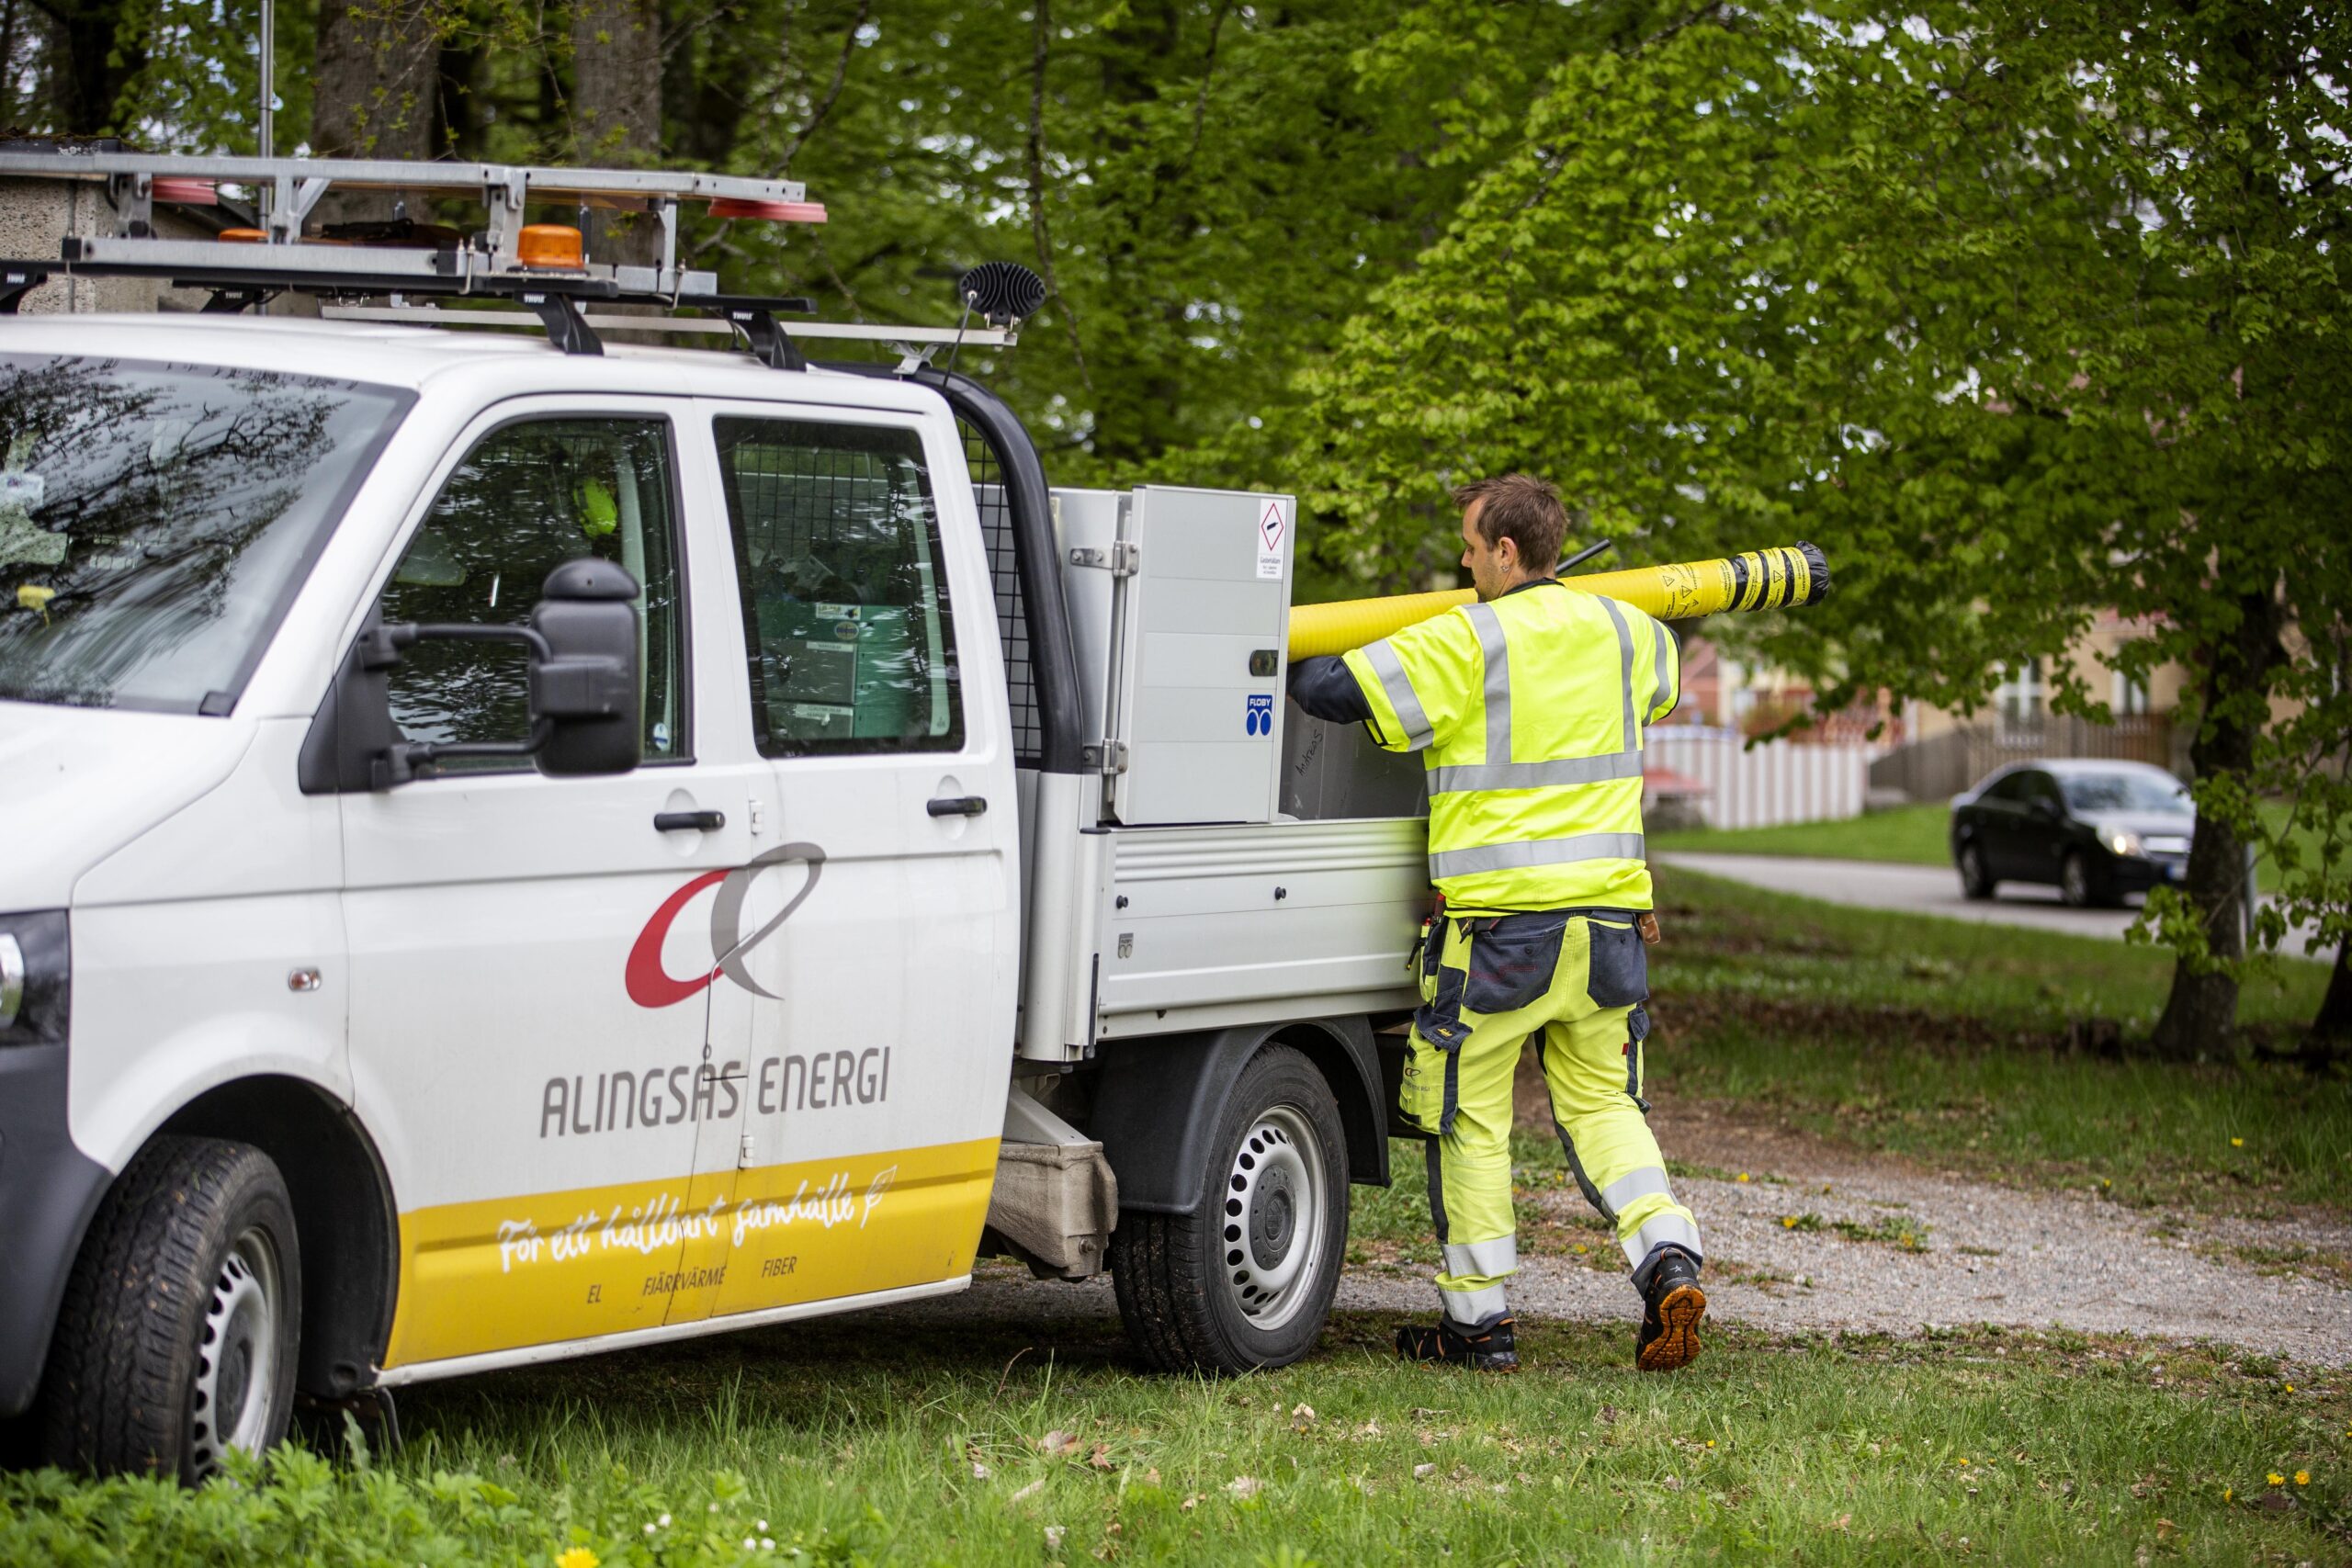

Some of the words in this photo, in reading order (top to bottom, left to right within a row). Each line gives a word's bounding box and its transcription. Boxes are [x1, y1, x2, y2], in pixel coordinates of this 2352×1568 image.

[524, 293, 545, 304] THULE
[732, 310, 753, 321] THULE
[1250, 698, 1272, 707] FLOBY
[539, 1043, 741, 1139] ALINGSÅS
[758, 1045, 891, 1115] ENERGI
[497, 1218, 545, 1273] För
[550, 1209, 600, 1262] ett
[601, 1192, 726, 1255] hållbart
[732, 1171, 855, 1247] samhälle
[586, 1284, 603, 1304] EL
[642, 1265, 728, 1296] FJÄRRVÄRME
[761, 1256, 798, 1279] FIBER
